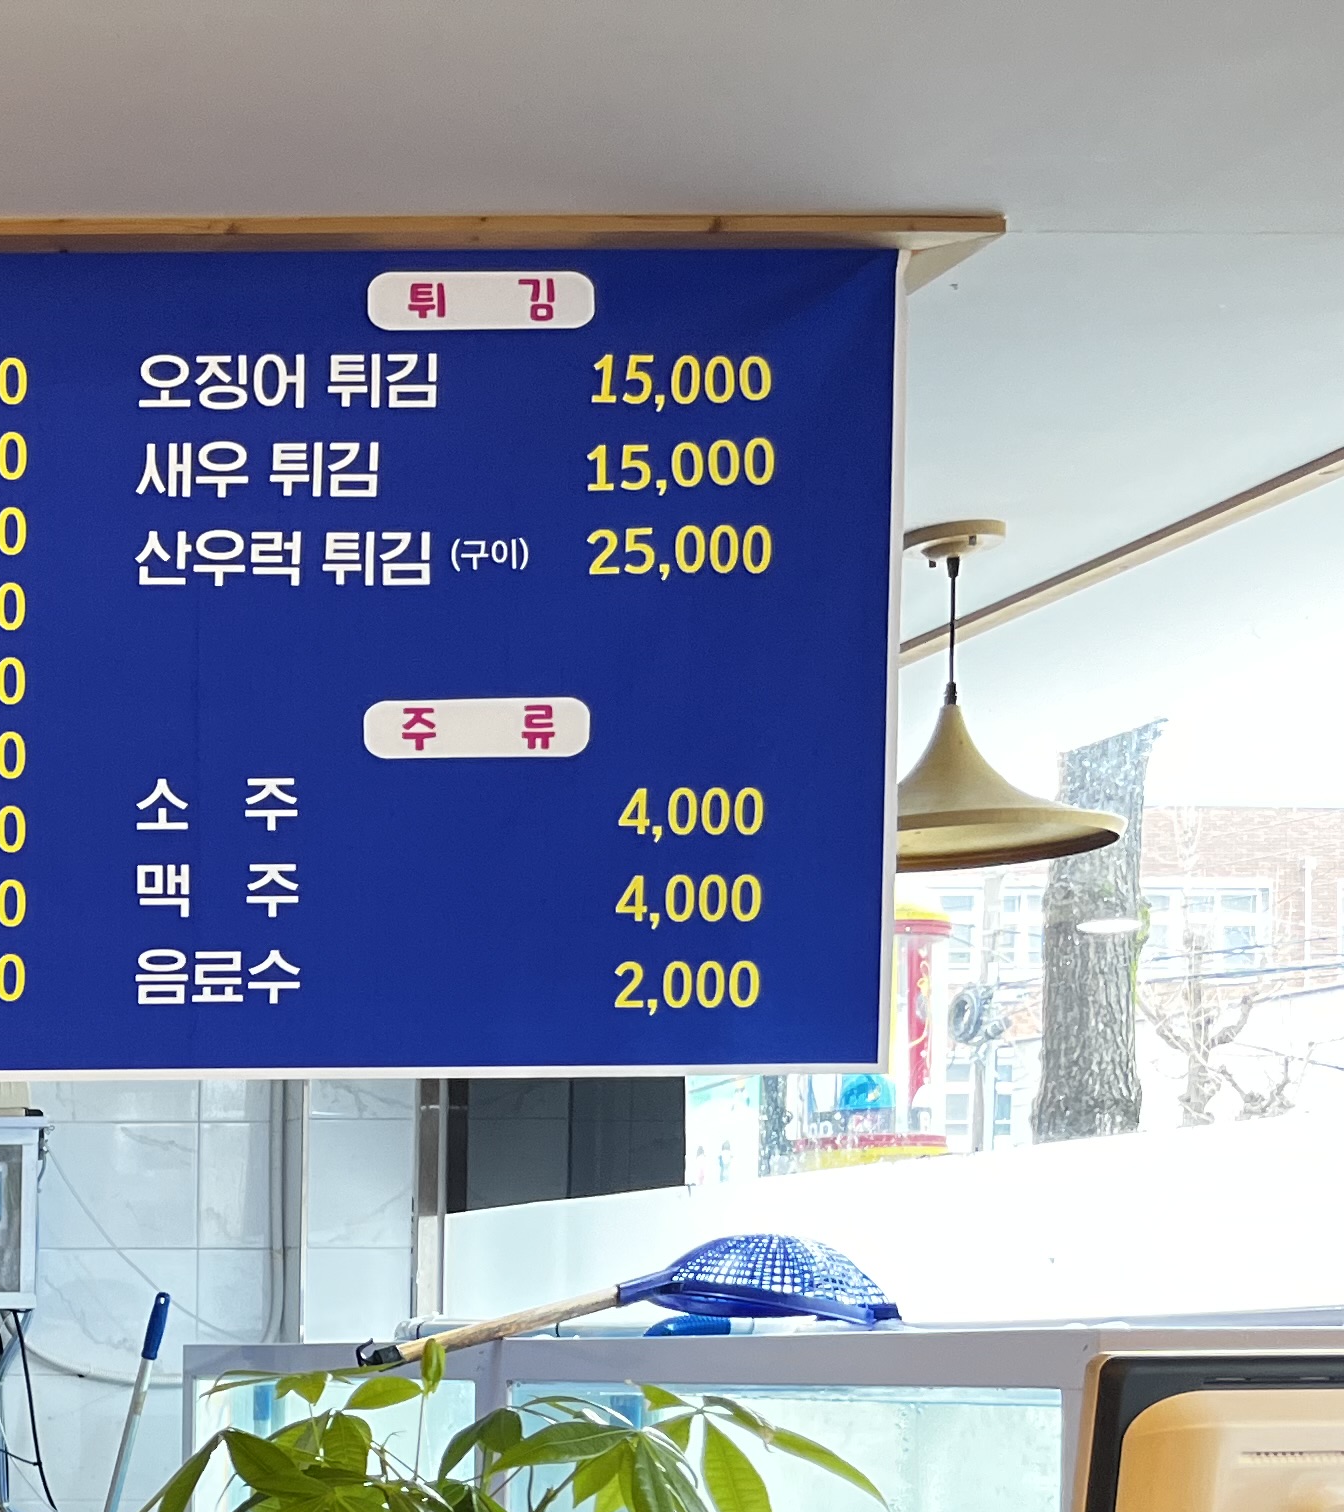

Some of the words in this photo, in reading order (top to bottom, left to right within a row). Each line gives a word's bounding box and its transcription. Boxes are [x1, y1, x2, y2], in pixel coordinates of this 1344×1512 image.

[139, 353, 306, 409] 오징어
[328, 353, 437, 409] 튀김
[592, 354, 771, 412] 15,000
[136, 441, 249, 498] 새우
[270, 441, 379, 498] 튀김
[587, 438, 774, 496] 15,000
[135, 530, 302, 586] 산우럭
[322, 531, 431, 586] 튀김
[450, 537, 529, 572] (구이)
[587, 525, 771, 580] 25,000
[618, 787, 763, 843] 4,000
[616, 874, 761, 929] 4,000
[135, 949, 300, 1004] 음료수
[615, 961, 759, 1015] 2,000
